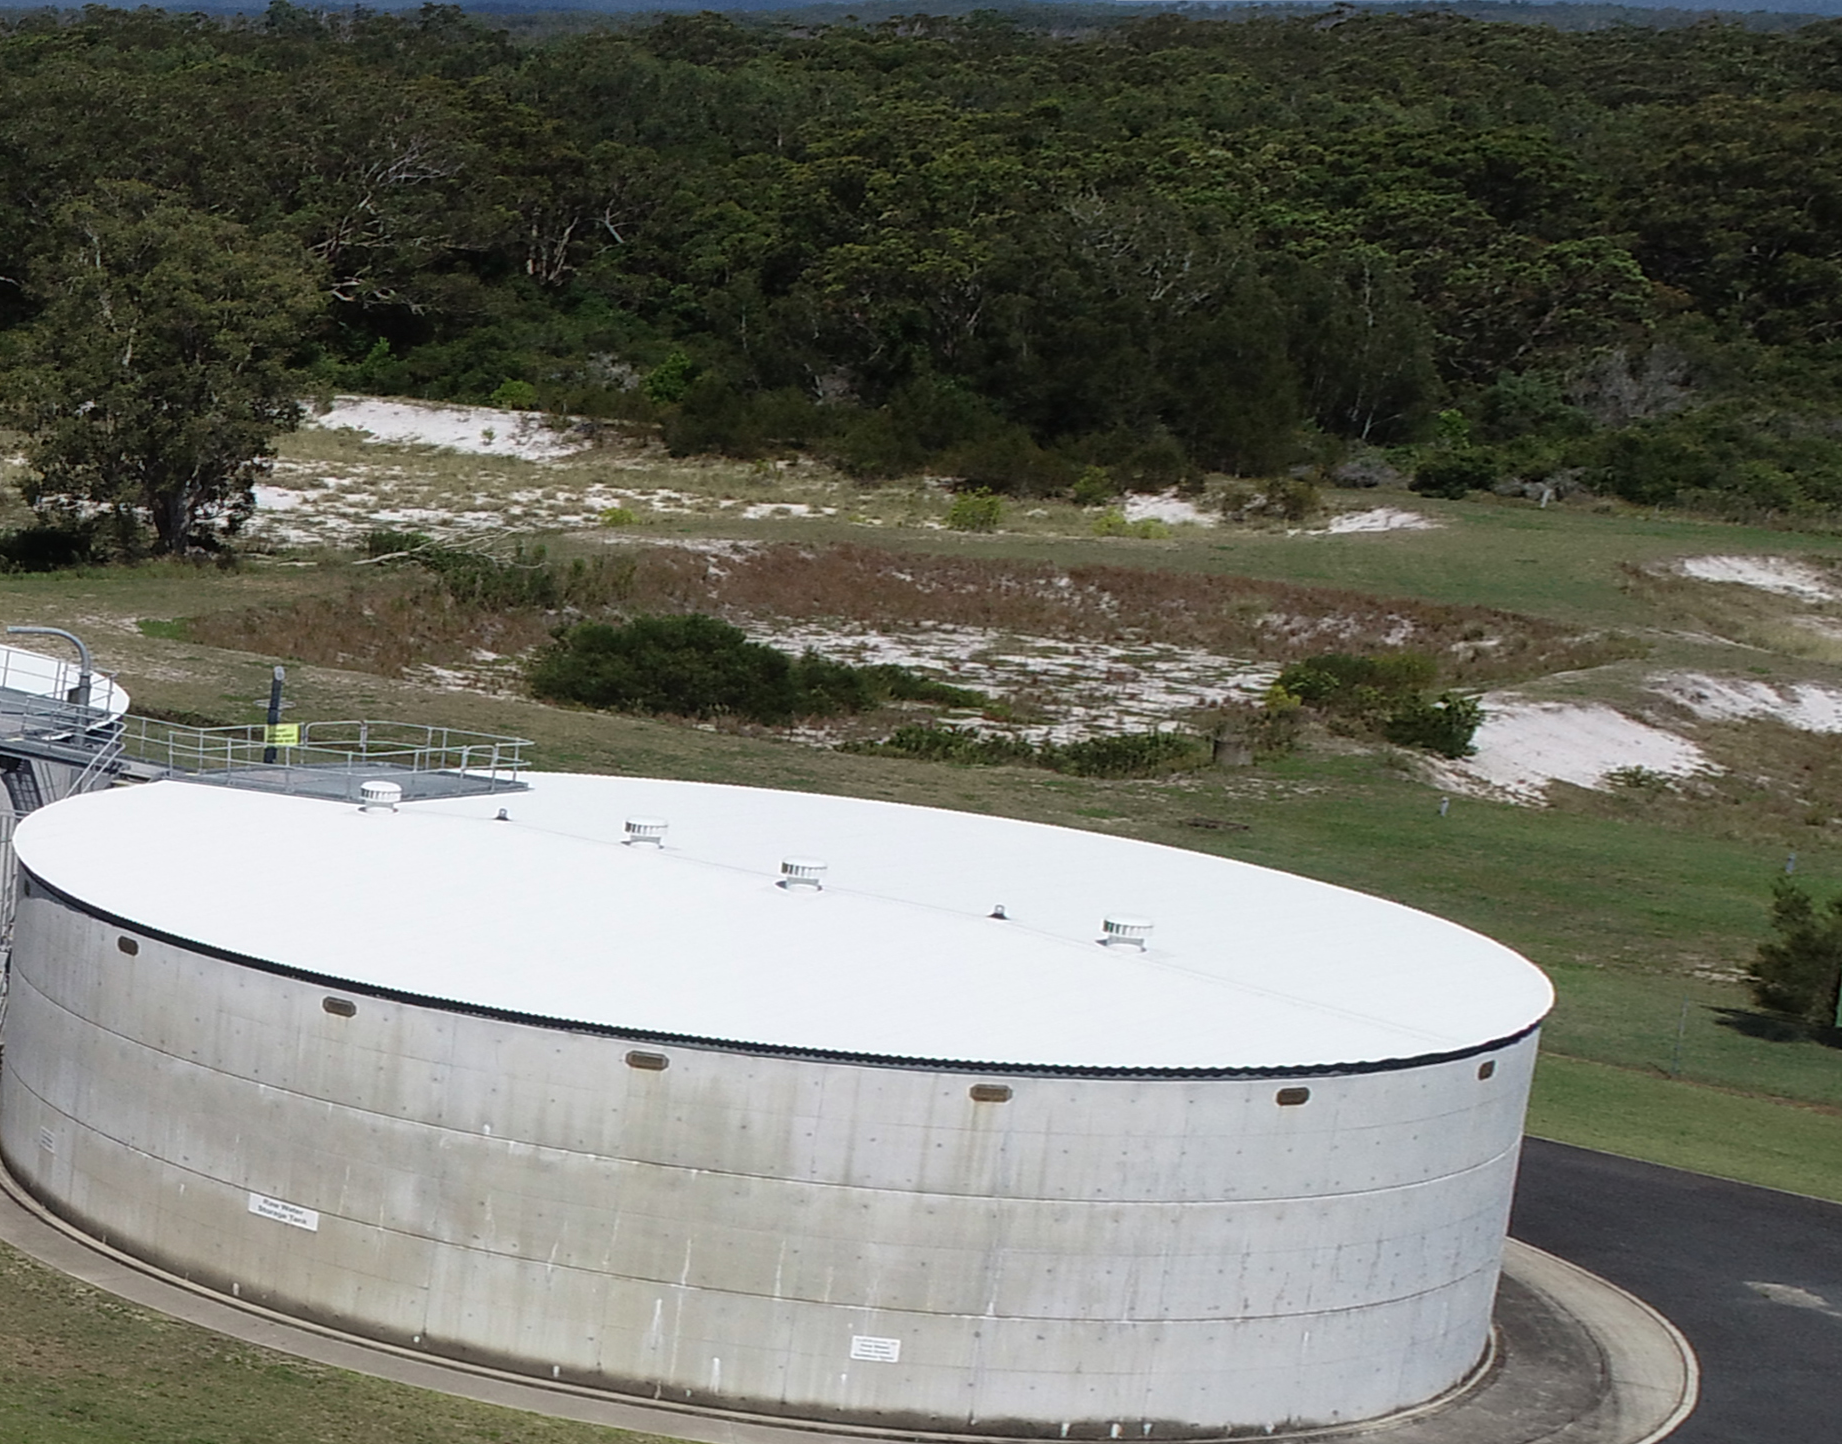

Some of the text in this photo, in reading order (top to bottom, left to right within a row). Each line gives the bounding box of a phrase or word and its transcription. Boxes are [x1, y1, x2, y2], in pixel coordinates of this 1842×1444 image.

[258, 1205, 307, 1224] Storage Tank
[281, 1205, 303, 1214] Water
